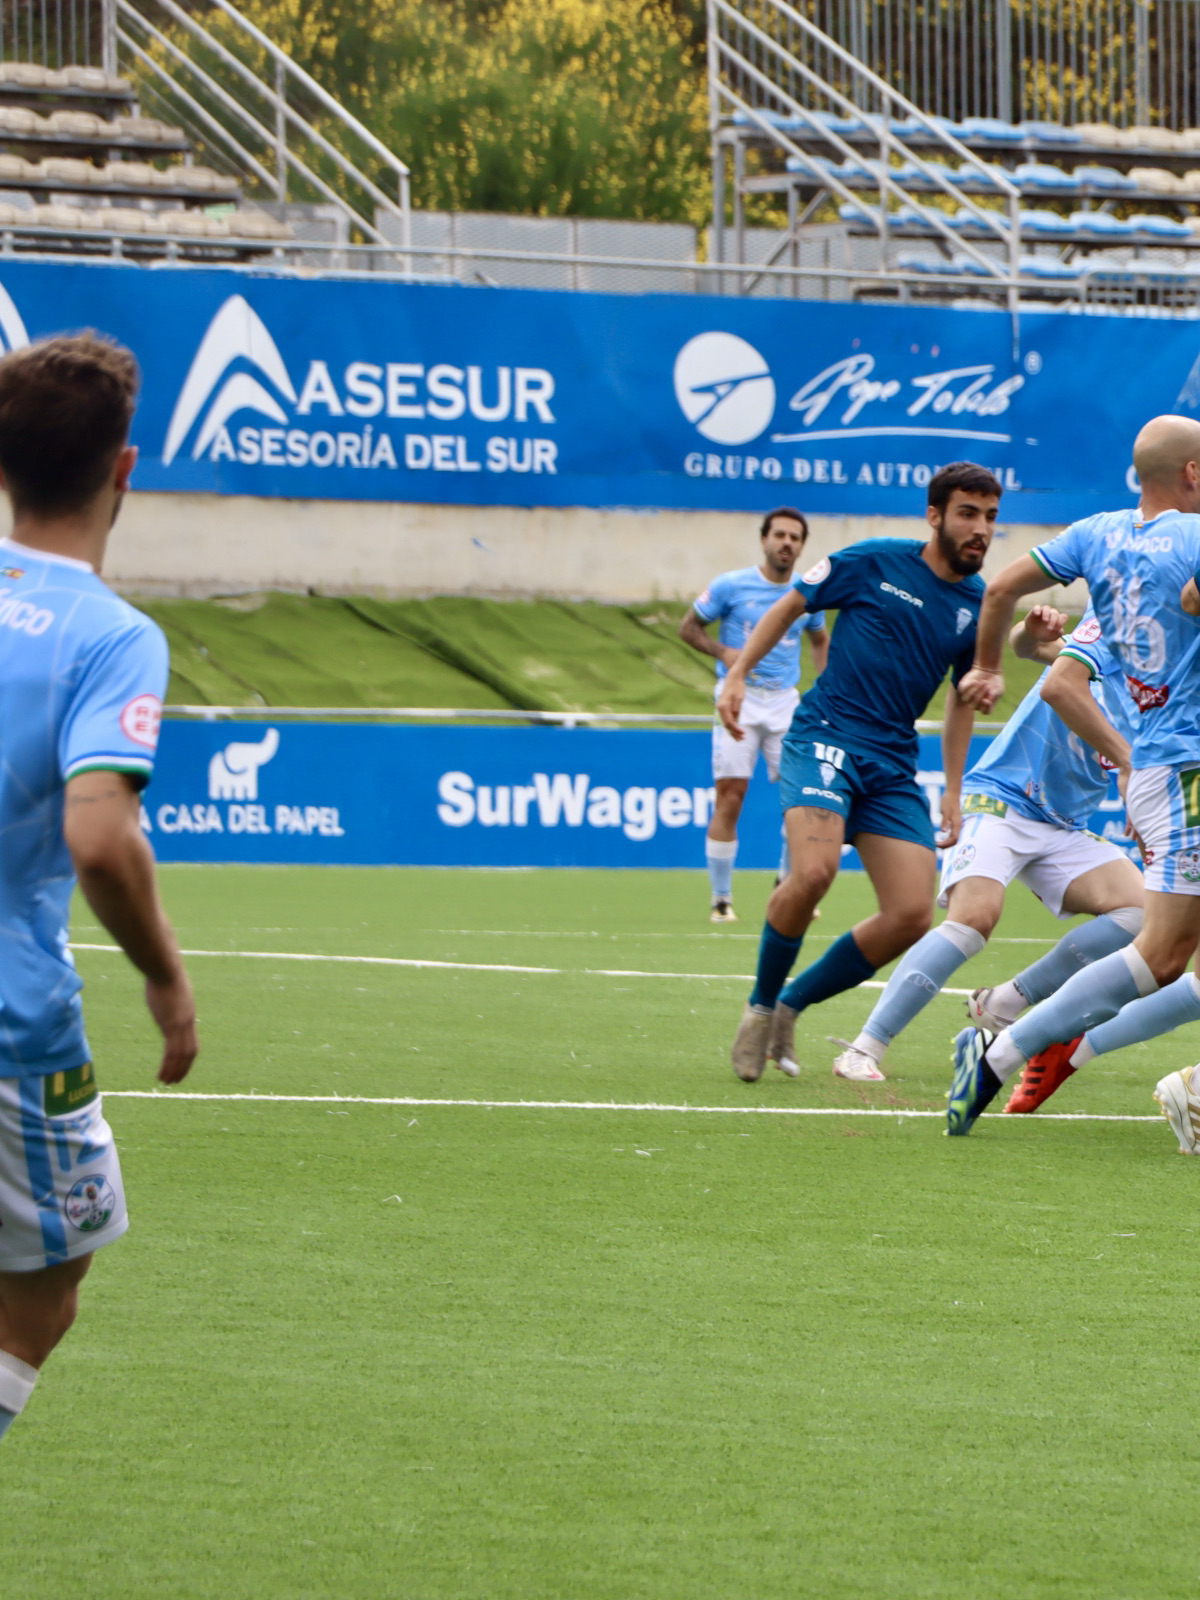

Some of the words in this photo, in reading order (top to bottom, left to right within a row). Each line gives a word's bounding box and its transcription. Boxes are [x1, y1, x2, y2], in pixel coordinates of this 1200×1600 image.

[295, 359, 556, 424] ASESUR
[405, 434, 482, 472] DEL
[486, 436, 558, 475] SUR
[684, 452, 782, 481] GRUPO
[793, 457, 848, 484] DEL
[812, 741, 846, 770] 10
[156, 803, 225, 835] CASA
[228, 804, 272, 835] DEL
[275, 804, 346, 837] PAPEL
[437, 771, 716, 842] SurWagen
